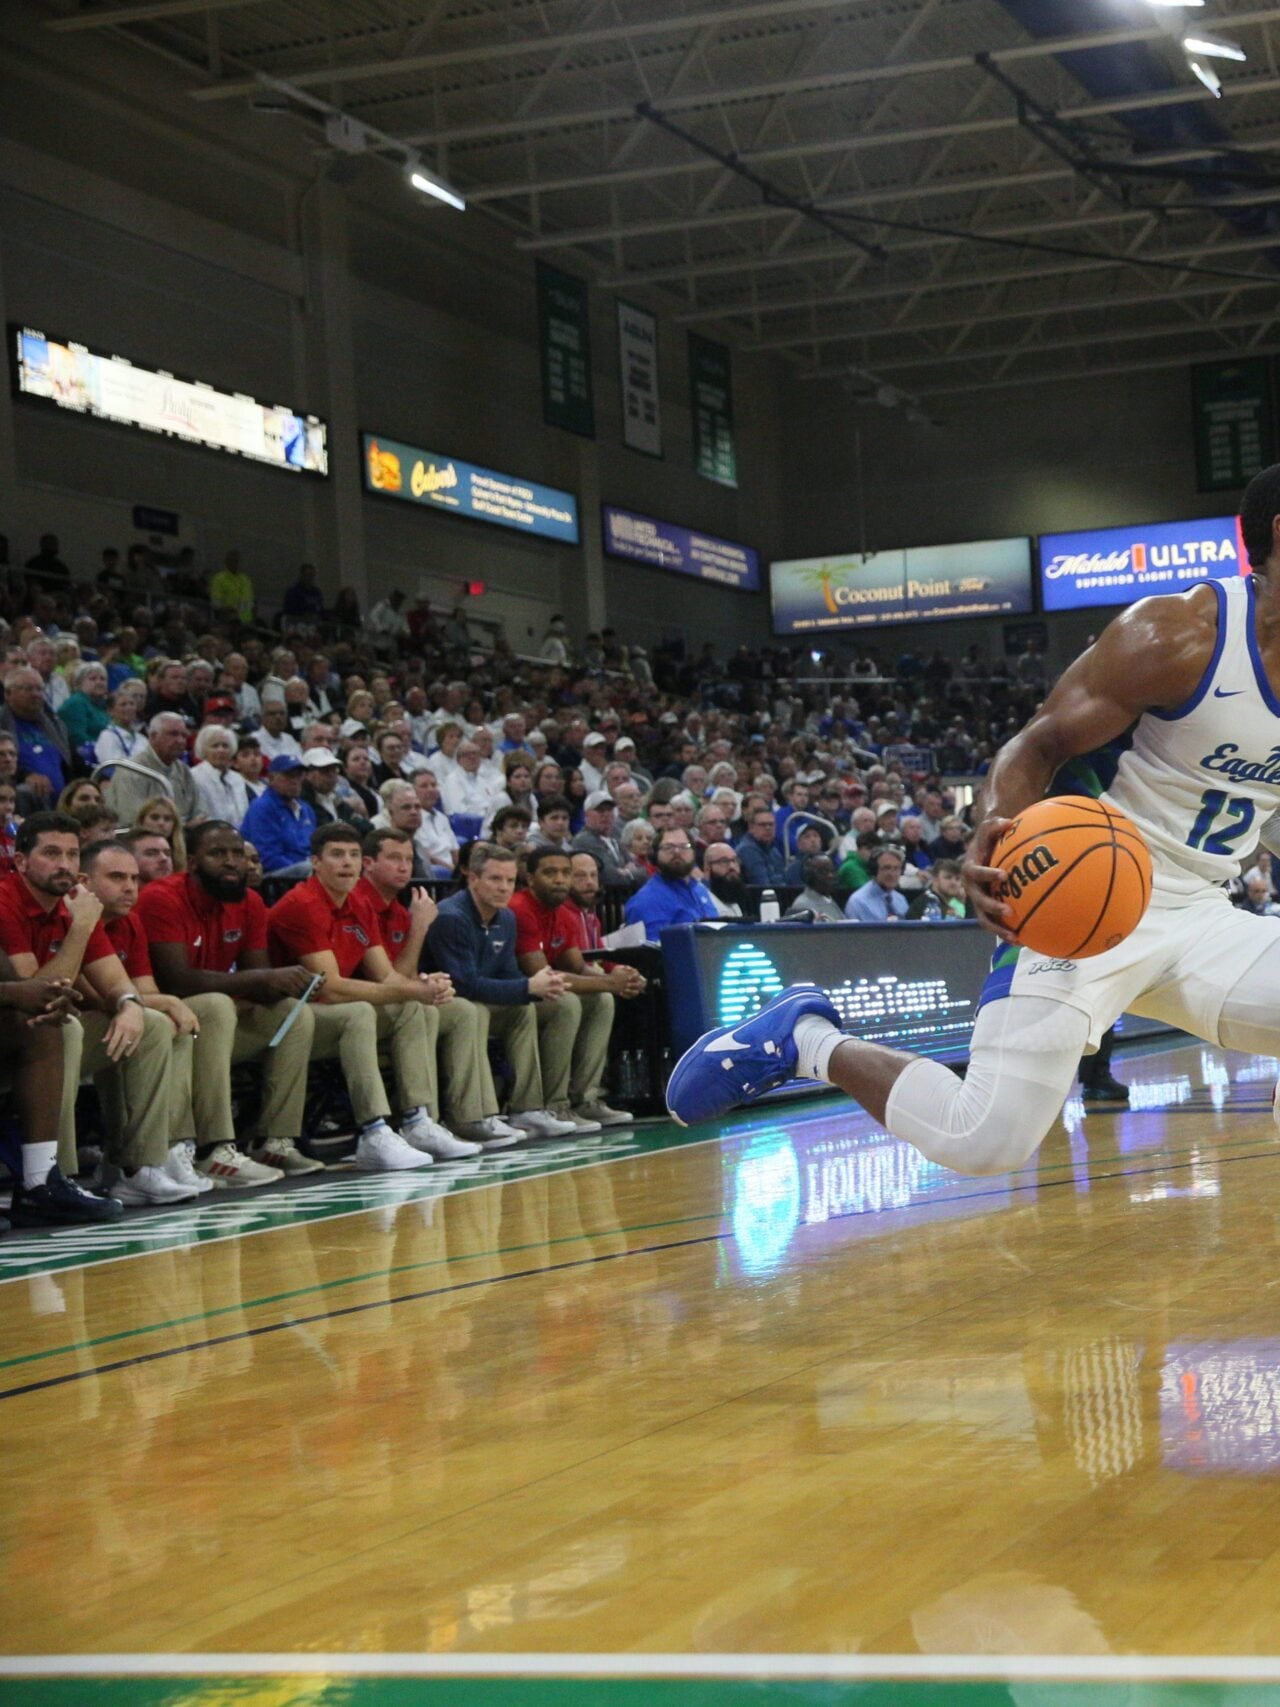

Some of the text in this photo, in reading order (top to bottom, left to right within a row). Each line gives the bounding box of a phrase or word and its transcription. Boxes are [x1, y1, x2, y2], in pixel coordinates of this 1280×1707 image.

[1044, 538, 1237, 580] Michelob ULTRA
[833, 585, 904, 606] Coconut
[906, 579, 950, 599] Point
[1075, 566, 1209, 590] SUPERIOR LIGHT BEER
[1185, 788, 1256, 856] 12
